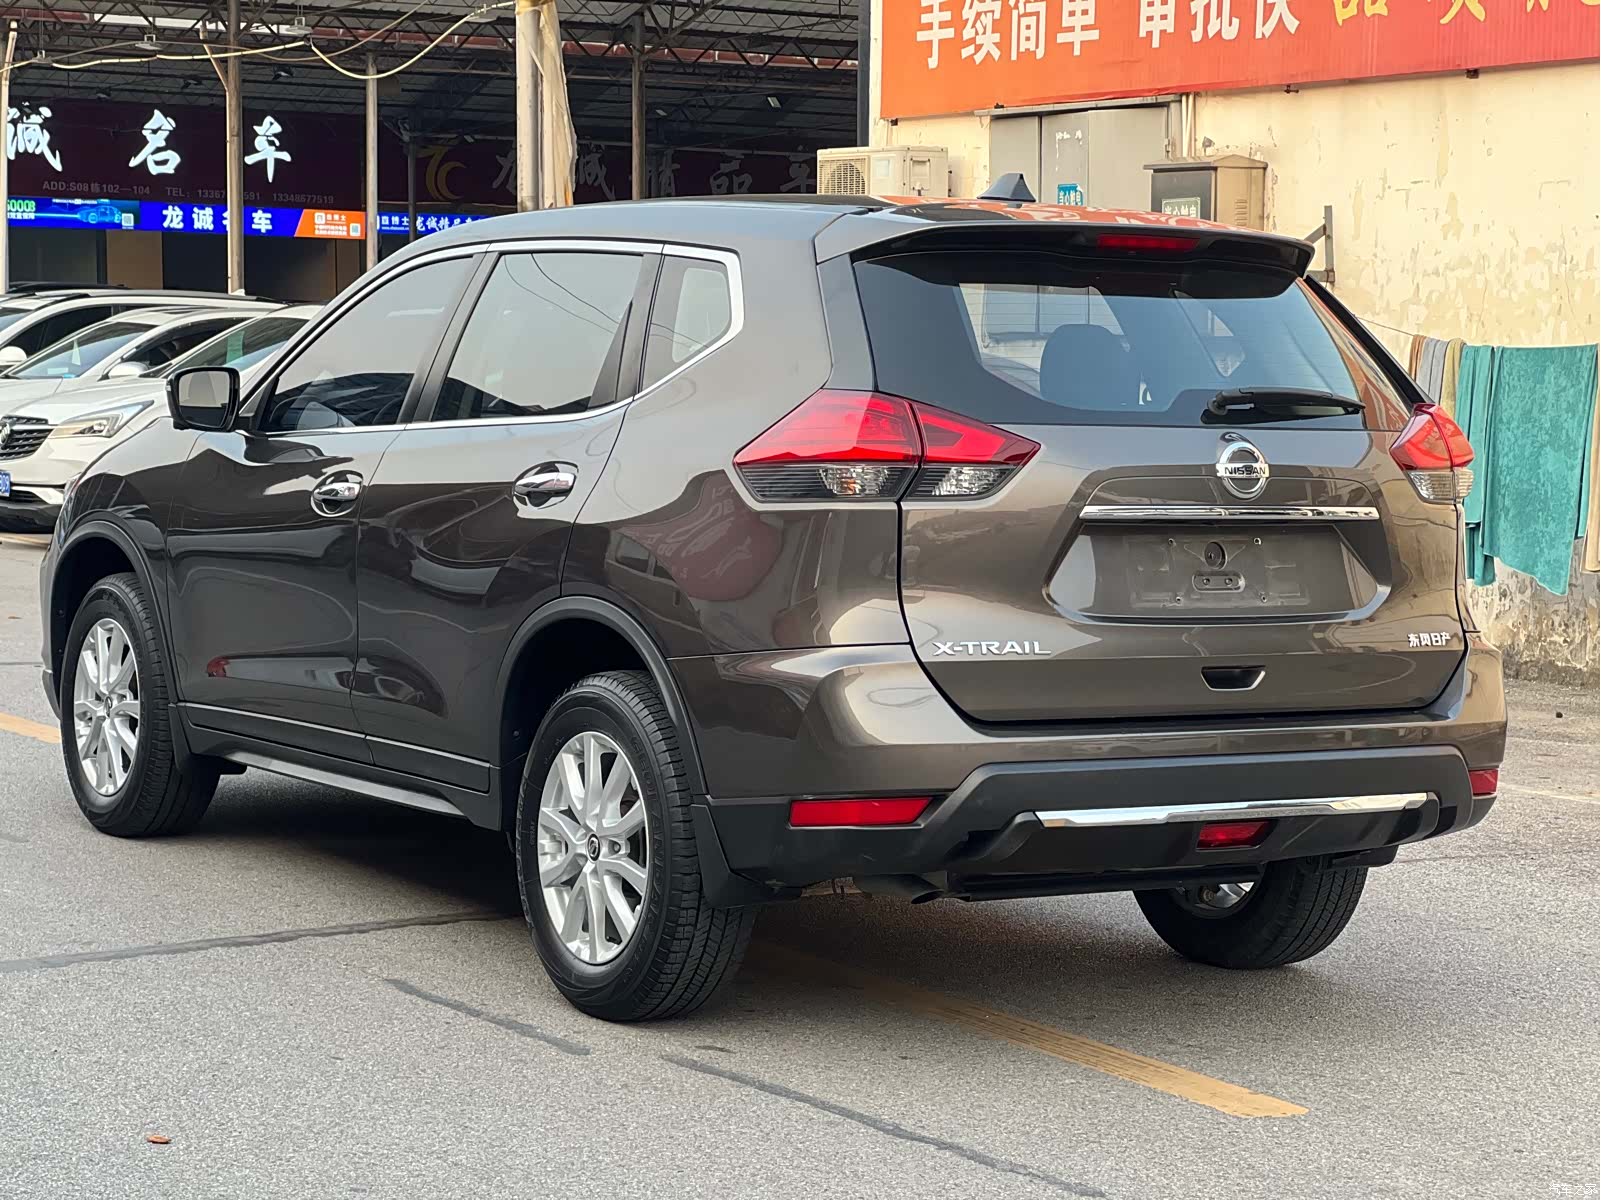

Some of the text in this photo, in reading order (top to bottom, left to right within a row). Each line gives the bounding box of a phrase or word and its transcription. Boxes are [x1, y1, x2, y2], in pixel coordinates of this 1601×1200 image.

[916, 0, 1100, 69] 手续简单
[197, 189, 261, 201] 13367591
[162, 204, 273, 234] 龙诚车
[1224, 465, 1266, 475] NISSAN
[1408, 631, 1452, 648] 东风日产
[932, 640, 1052, 656] X-TRAIL
